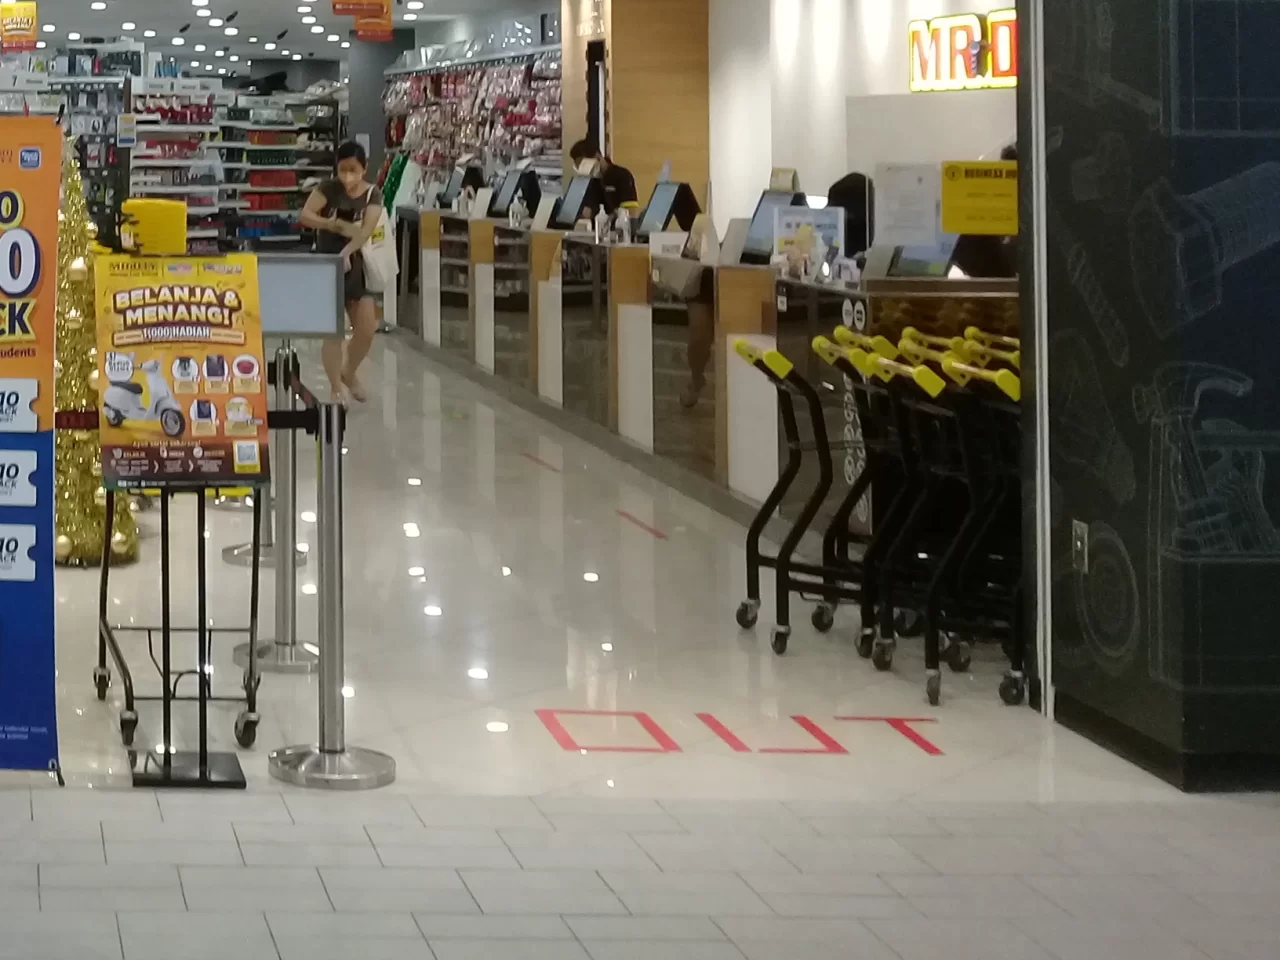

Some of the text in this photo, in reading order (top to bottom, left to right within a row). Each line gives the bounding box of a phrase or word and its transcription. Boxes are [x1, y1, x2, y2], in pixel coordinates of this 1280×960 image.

[115, 285, 239, 309] BELANJA &
[125, 304, 230, 327] MENANG!
[172, 325, 210, 338] HADIAH
[535, 709, 945, 756] OUT
